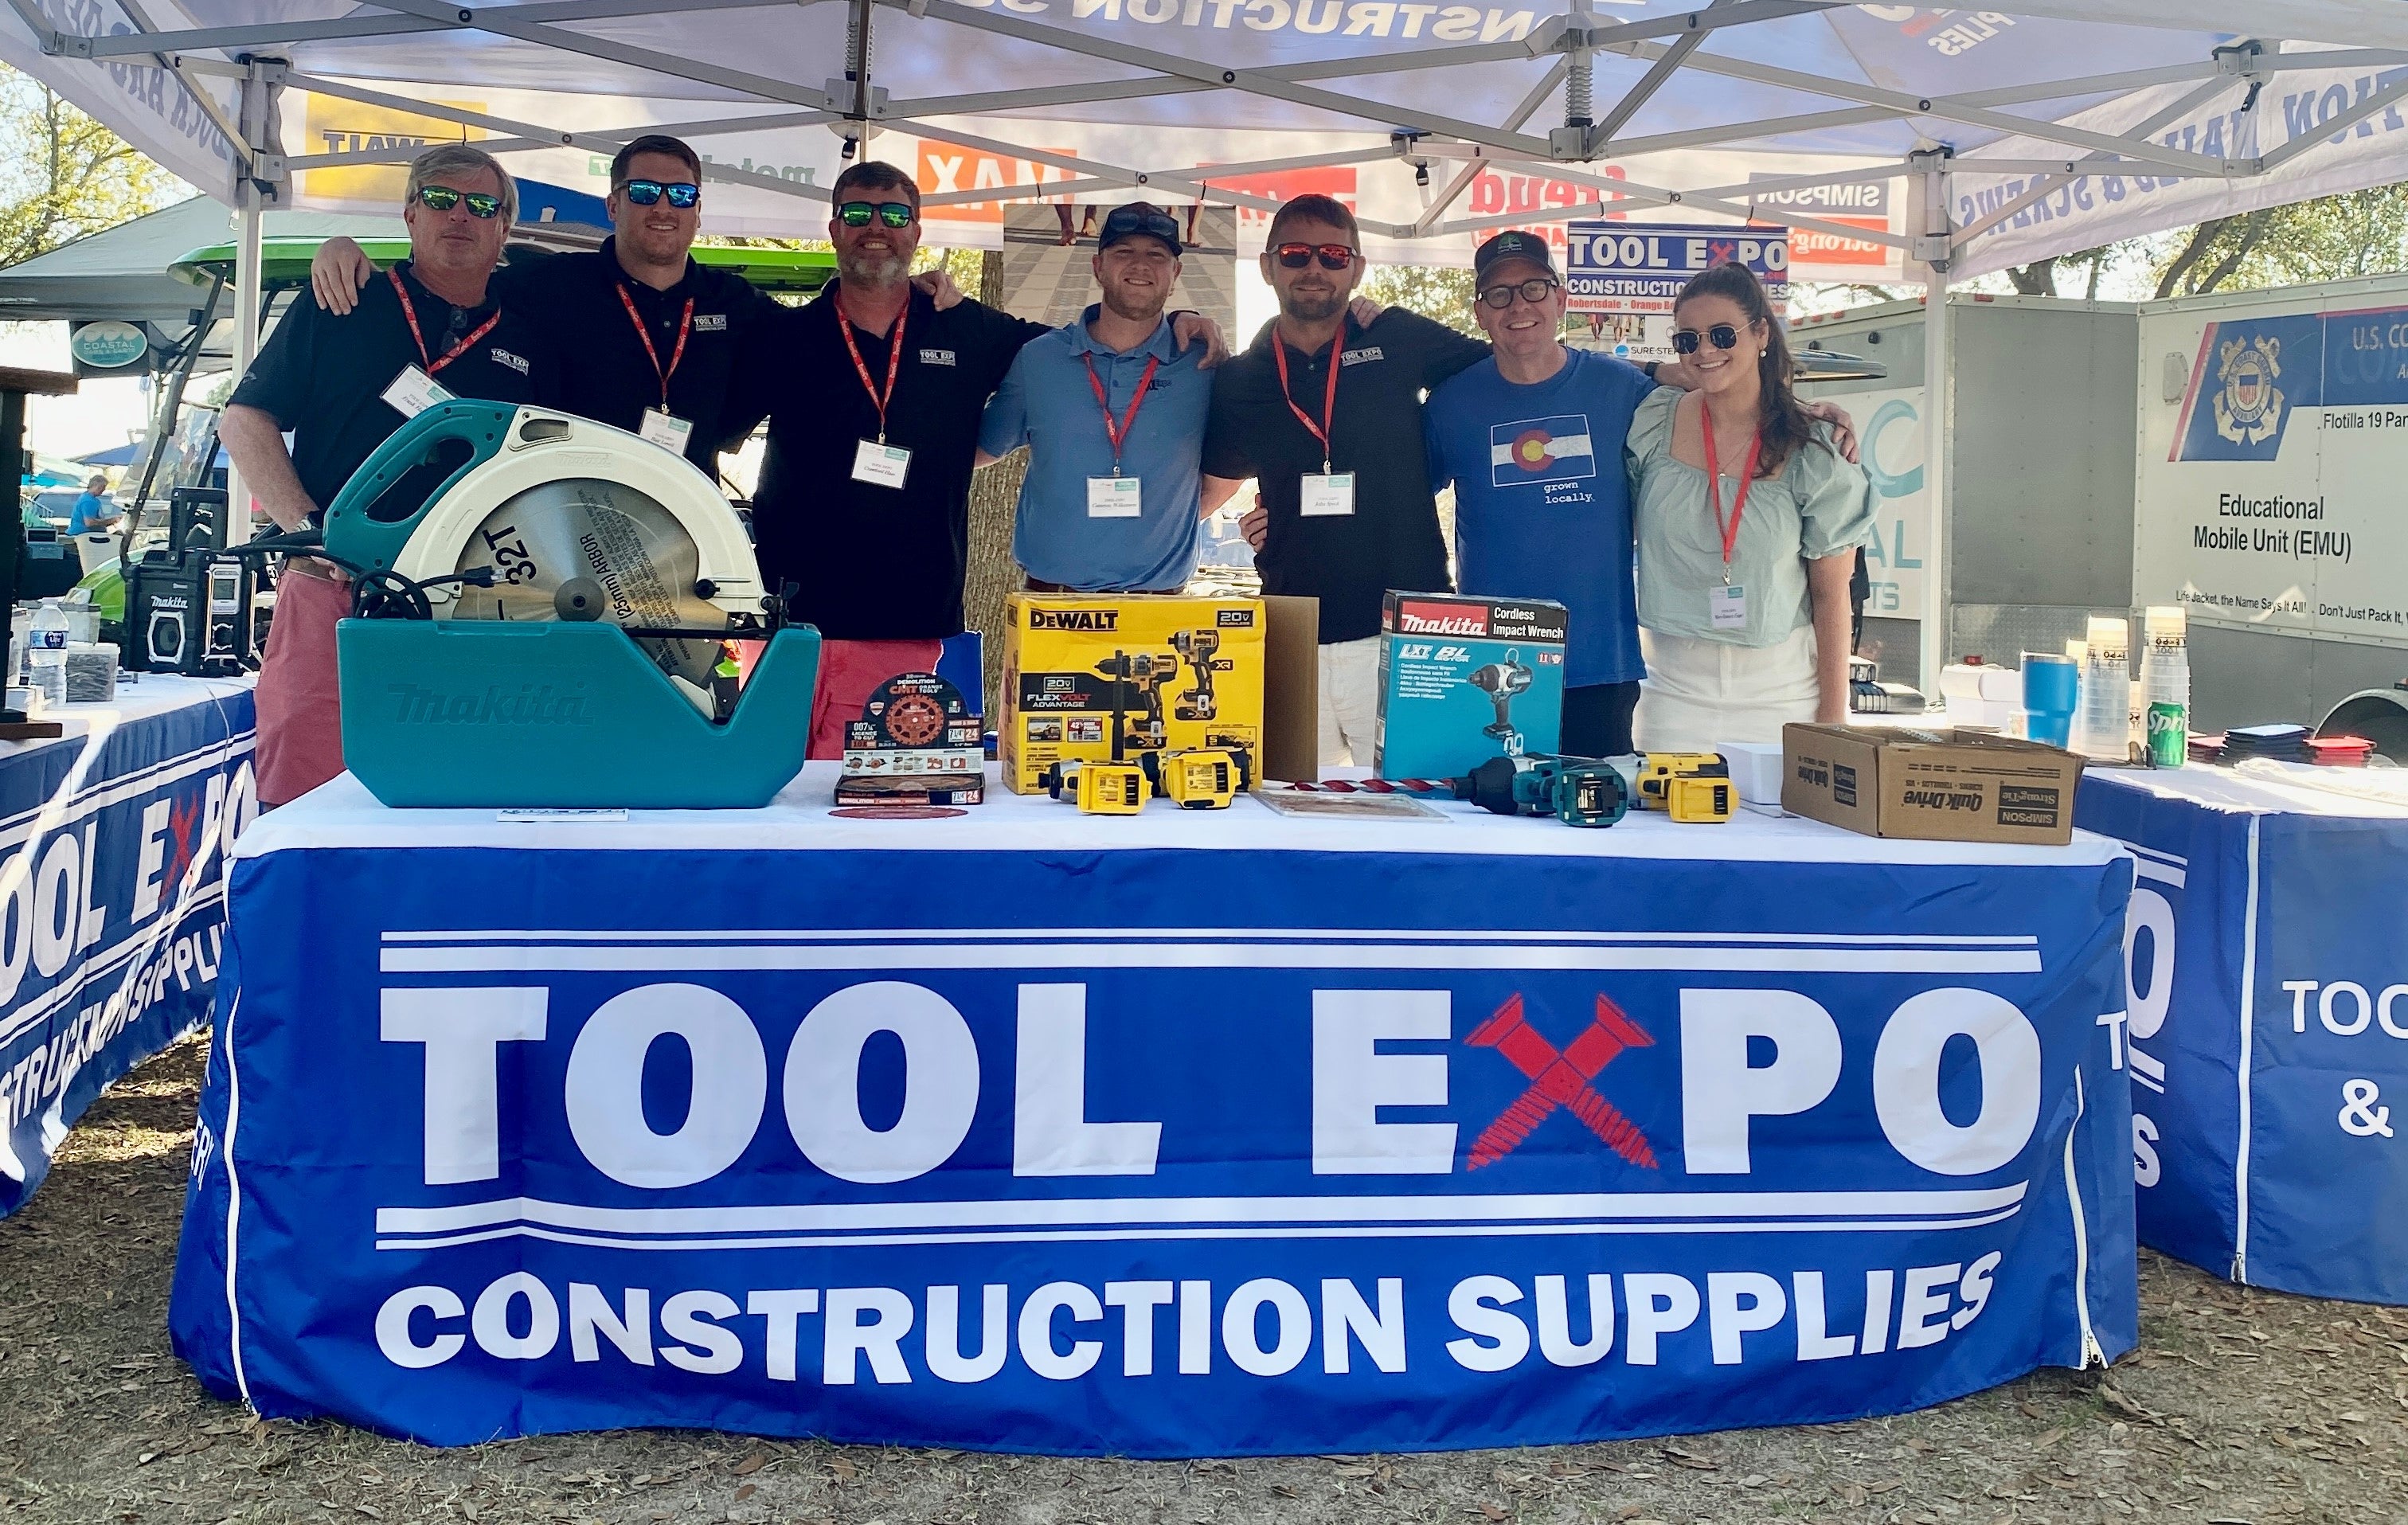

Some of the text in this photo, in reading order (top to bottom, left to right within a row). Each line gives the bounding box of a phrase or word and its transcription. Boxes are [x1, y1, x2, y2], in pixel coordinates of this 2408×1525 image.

[1568, 235, 1669, 268] TOOL
[1687, 239, 1789, 272] EXPO
[1568, 279, 1685, 297] CONSTRUCTIO
[1568, 298, 1674, 311] Robertsdale Orange Be
[84, 341, 135, 350] COASTAL
[2353, 326, 2383, 350] U.S.
[491, 350, 511, 361] TOOL
[1341, 351, 1360, 362] TOOL
[1362, 349, 1382, 358] EXPO
[2324, 412, 2382, 429] Flotilla 19
[1543, 481, 1578, 494] grown
[2219, 493, 2324, 520] Educational
[1864, 520, 1923, 569] AL
[2194, 525, 2351, 564] Mobile Unit (EMU)
[483, 524, 538, 587] 32T
[579, 532, 637, 620] (25mm) ARBOR
[1870, 582, 1900, 610] TS
[2175, 590, 2191, 602] Life
[2191, 592, 2218, 605] Jacket,
[2221, 594, 2234, 606] the
[2236, 596, 2259, 609] Name
[2261, 597, 2282, 614] Says
[2292, 600, 2307, 614] All!
[1493, 606, 1535, 621] Cordless
[2319, 604, 2344, 618] Don't
[2345, 606, 2366, 620] Just
[2368, 608, 2392, 624] Pack
[1492, 624, 1564, 639] Impact Wrench
[1398, 644, 1470, 659] LXT BL
[1215, 661, 1232, 670] XR
[889, 685, 918, 694] CMT
[965, 729, 979, 738] 24
[967, 792, 979, 800] 24
[1903, 790, 1982, 811] Quik Drive
[2002, 811, 2053, 824] SIMPSON
[0, 821, 107, 1007] OOL
[2125, 889, 2175, 1039] O
[2282, 980, 2408, 1036] TOO
[380, 980, 2042, 1188] TOOL EXPO
[2338, 1079, 2394, 1138] &
[2132, 1113, 2160, 1187] S
[375, 1250, 2003, 1386] CONSTRUCTION SUPPLIES
